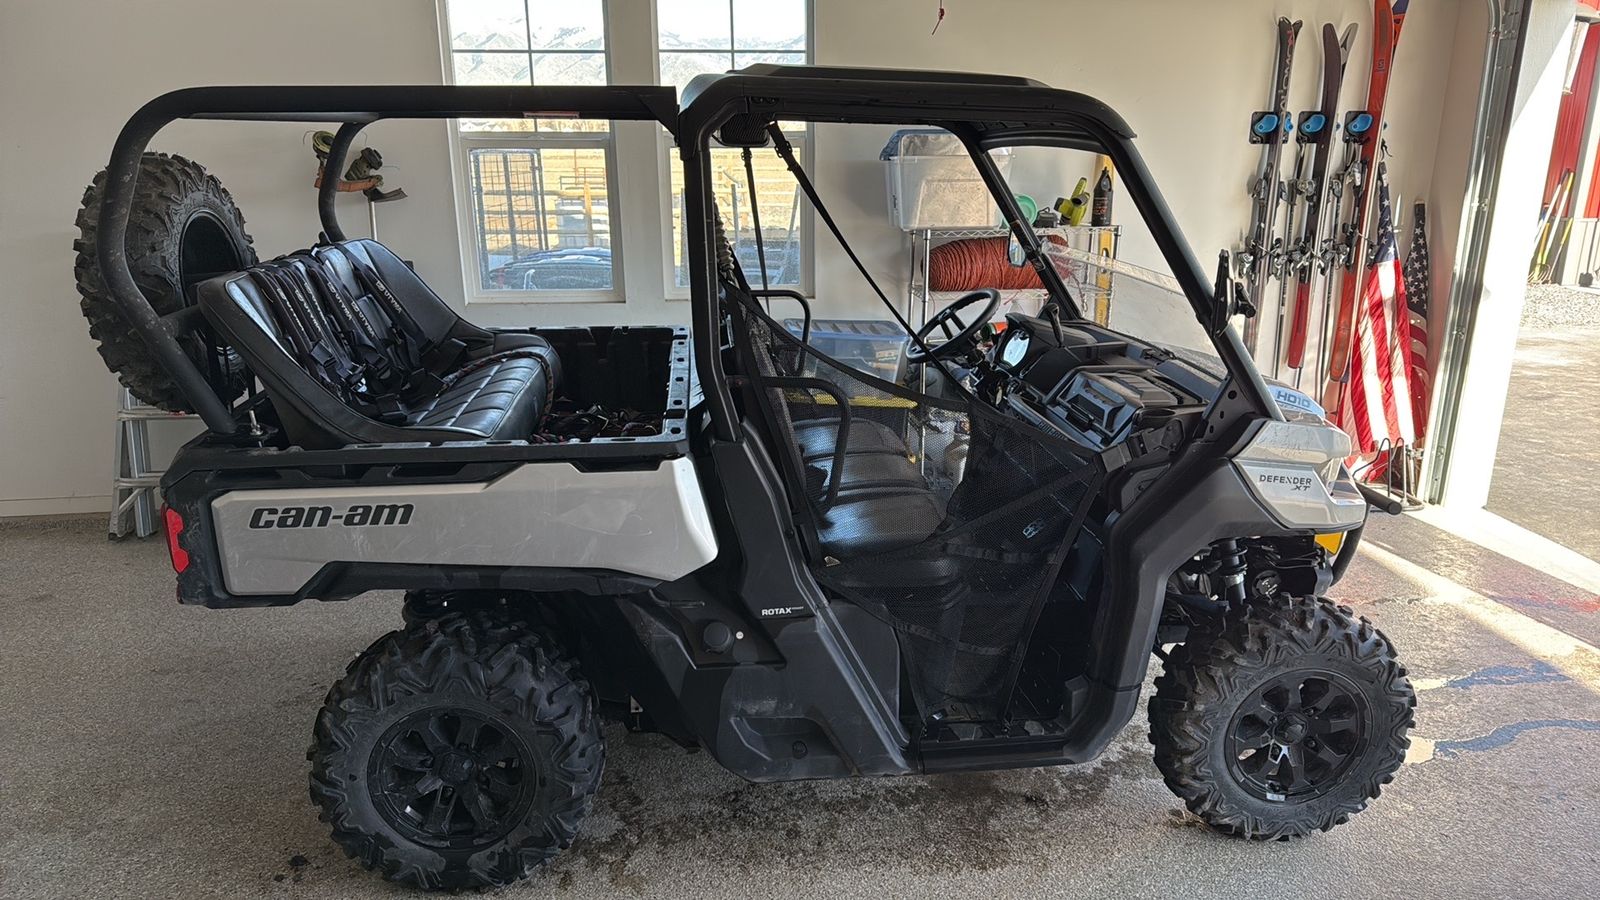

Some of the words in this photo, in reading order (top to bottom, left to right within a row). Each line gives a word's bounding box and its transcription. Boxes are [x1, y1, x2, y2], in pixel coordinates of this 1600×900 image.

[1277, 391, 1311, 408] HD10
[1260, 474, 1312, 485] DEFENDER
[249, 503, 415, 529] can-am
[761, 607, 792, 616] ROTAX
